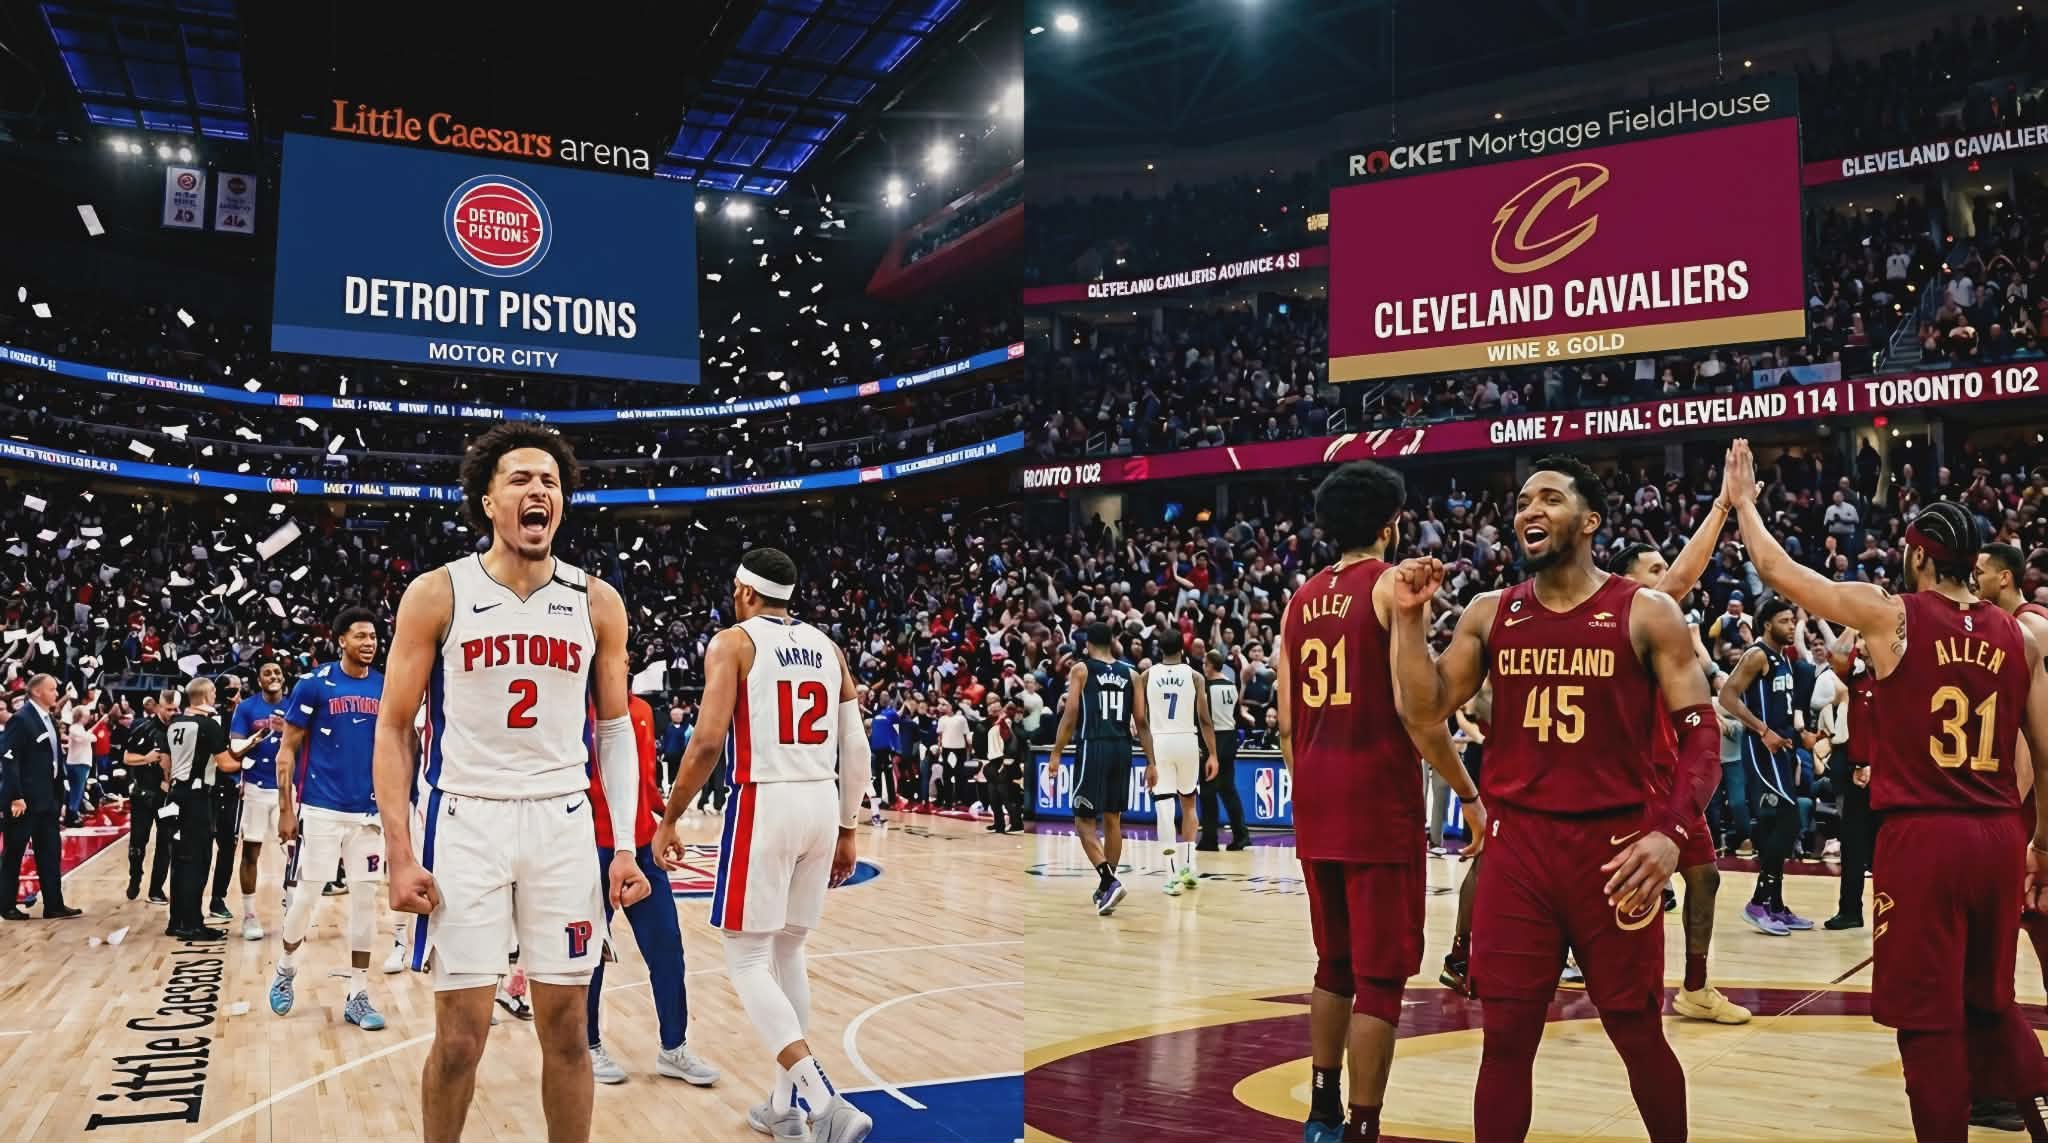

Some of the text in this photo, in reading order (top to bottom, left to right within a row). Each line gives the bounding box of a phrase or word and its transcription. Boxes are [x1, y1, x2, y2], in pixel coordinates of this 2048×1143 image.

[331, 100, 650, 170] Little Caesars arena
[1468, 119, 1601, 158] Mortgage
[1608, 91, 1770, 136] FieldHouse
[1842, 142, 1950, 177] CLEVELAND
[469, 207, 529, 229] DETROIT
[469, 224, 529, 244] PISTONS
[345, 276, 637, 339] DETROIT PISTONS
[1374, 259, 1749, 339] CLEVELAND CAVALIERS
[429, 343, 559, 369] MOTOR CITY
[1487, 333, 1625, 362] WINE & GOLD
[1490, 417, 1547, 444] GAME
[1552, 415, 1564, 437] 7
[1585, 407, 1652, 435] FINAL:
[1658, 393, 1786, 428] CLEVELAND
[1793, 389, 1838, 414] 114
[1865, 373, 1983, 408] TORONTO
[1990, 366, 2040, 393] 102
[461, 633, 582, 673] PISTONS
[1301, 634, 1352, 708] 31
[1498, 648, 1615, 677] CLEVELAND
[1935, 636, 2006, 675] ALLEN
[507, 678, 538, 728] 2
[777, 680, 829, 744] 12
[1099, 690, 1125, 720] 14
[1163, 693, 1179, 719] 7
[1523, 685, 1585, 743] 45
[1930, 685, 2000, 772] 31
[126, 959, 224, 1031] Caesars
[84, 1036, 212, 1131] Little
